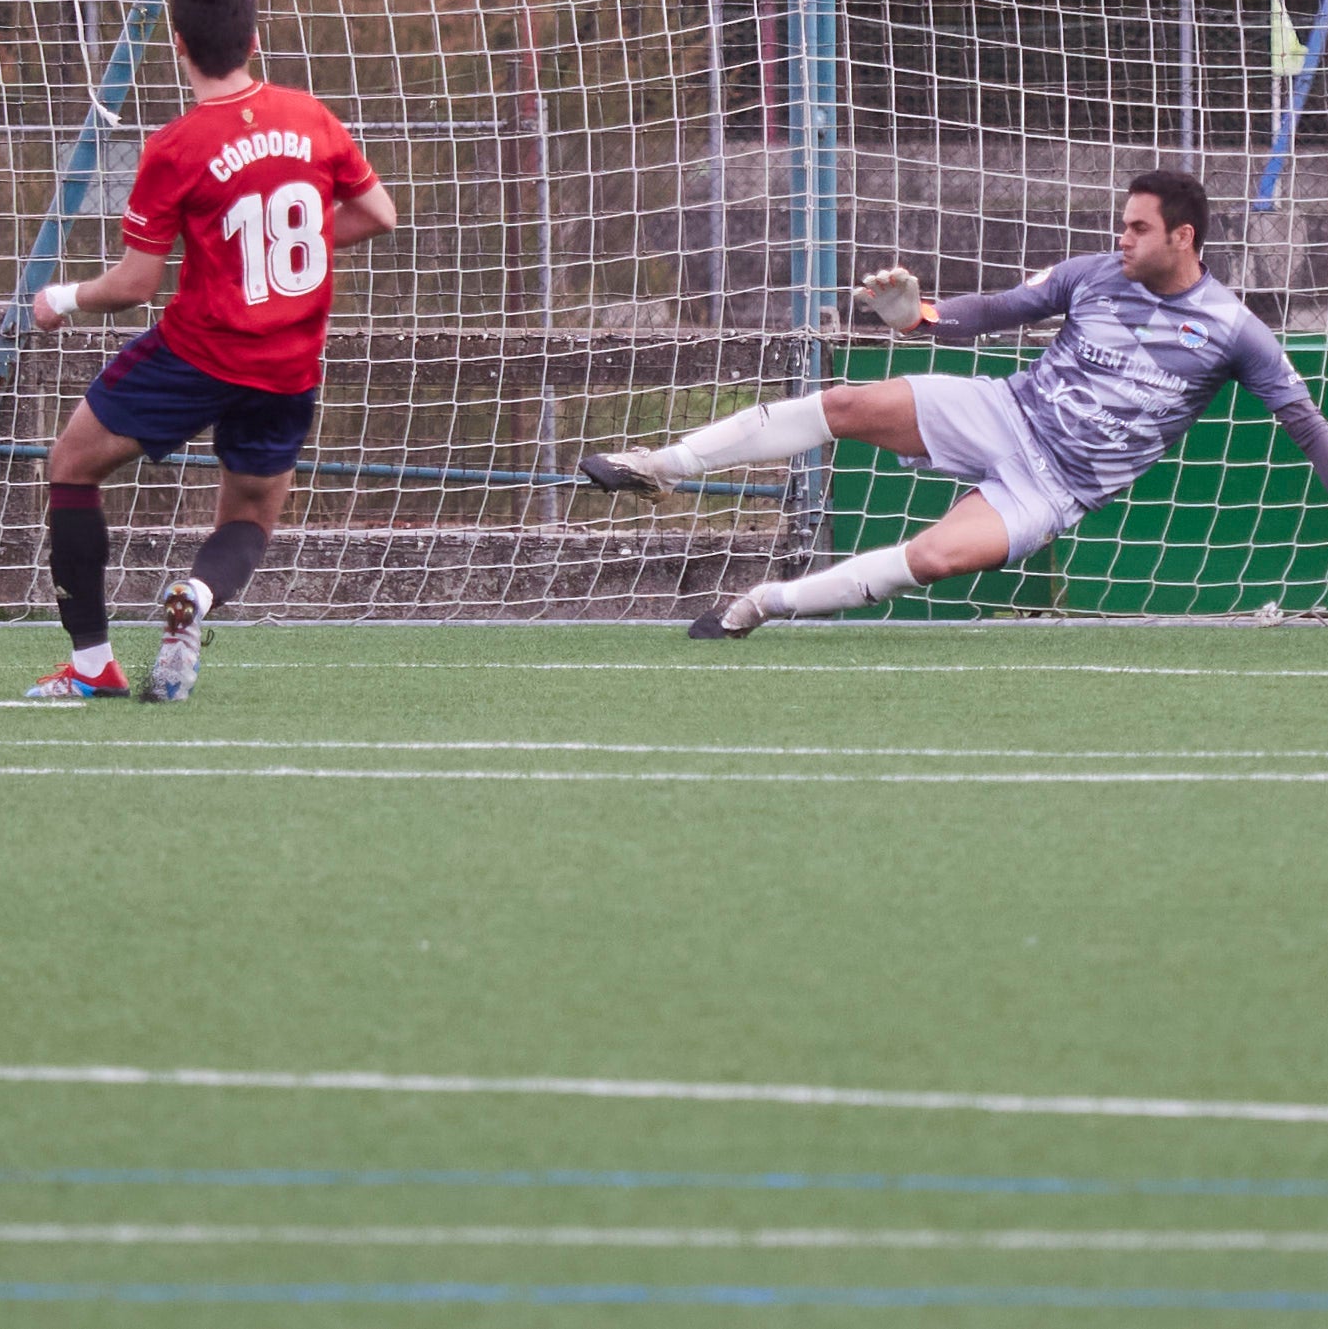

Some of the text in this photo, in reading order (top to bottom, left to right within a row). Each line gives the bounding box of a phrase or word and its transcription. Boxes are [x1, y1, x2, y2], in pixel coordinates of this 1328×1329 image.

[209, 131, 312, 182] CÓRDOBA
[223, 182, 328, 305] 18
[1131, 389, 1170, 417] GRUPO
